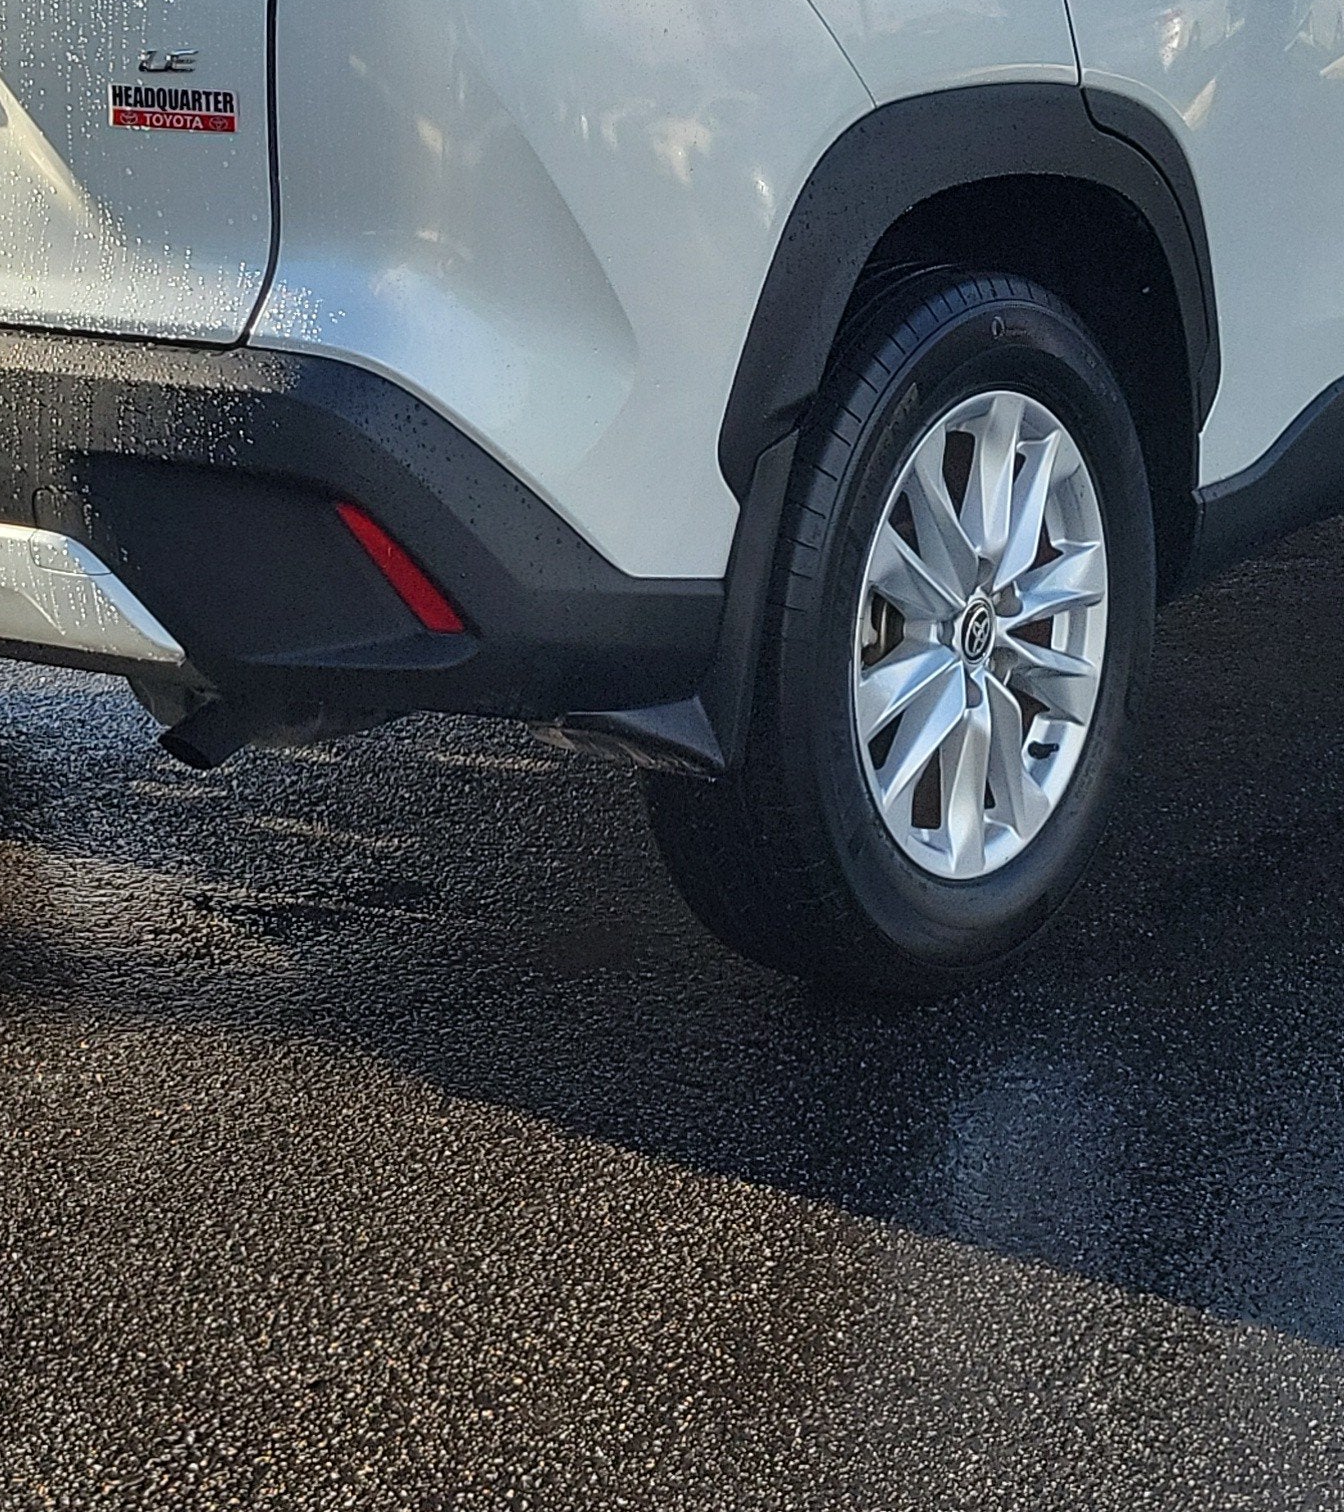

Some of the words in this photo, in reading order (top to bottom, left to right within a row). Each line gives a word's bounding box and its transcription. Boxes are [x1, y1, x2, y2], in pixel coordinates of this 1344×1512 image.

[138, 48, 199, 73] LE
[111, 84, 235, 114] HEADQUARTER
[143, 112, 204, 130] TOYOTA
